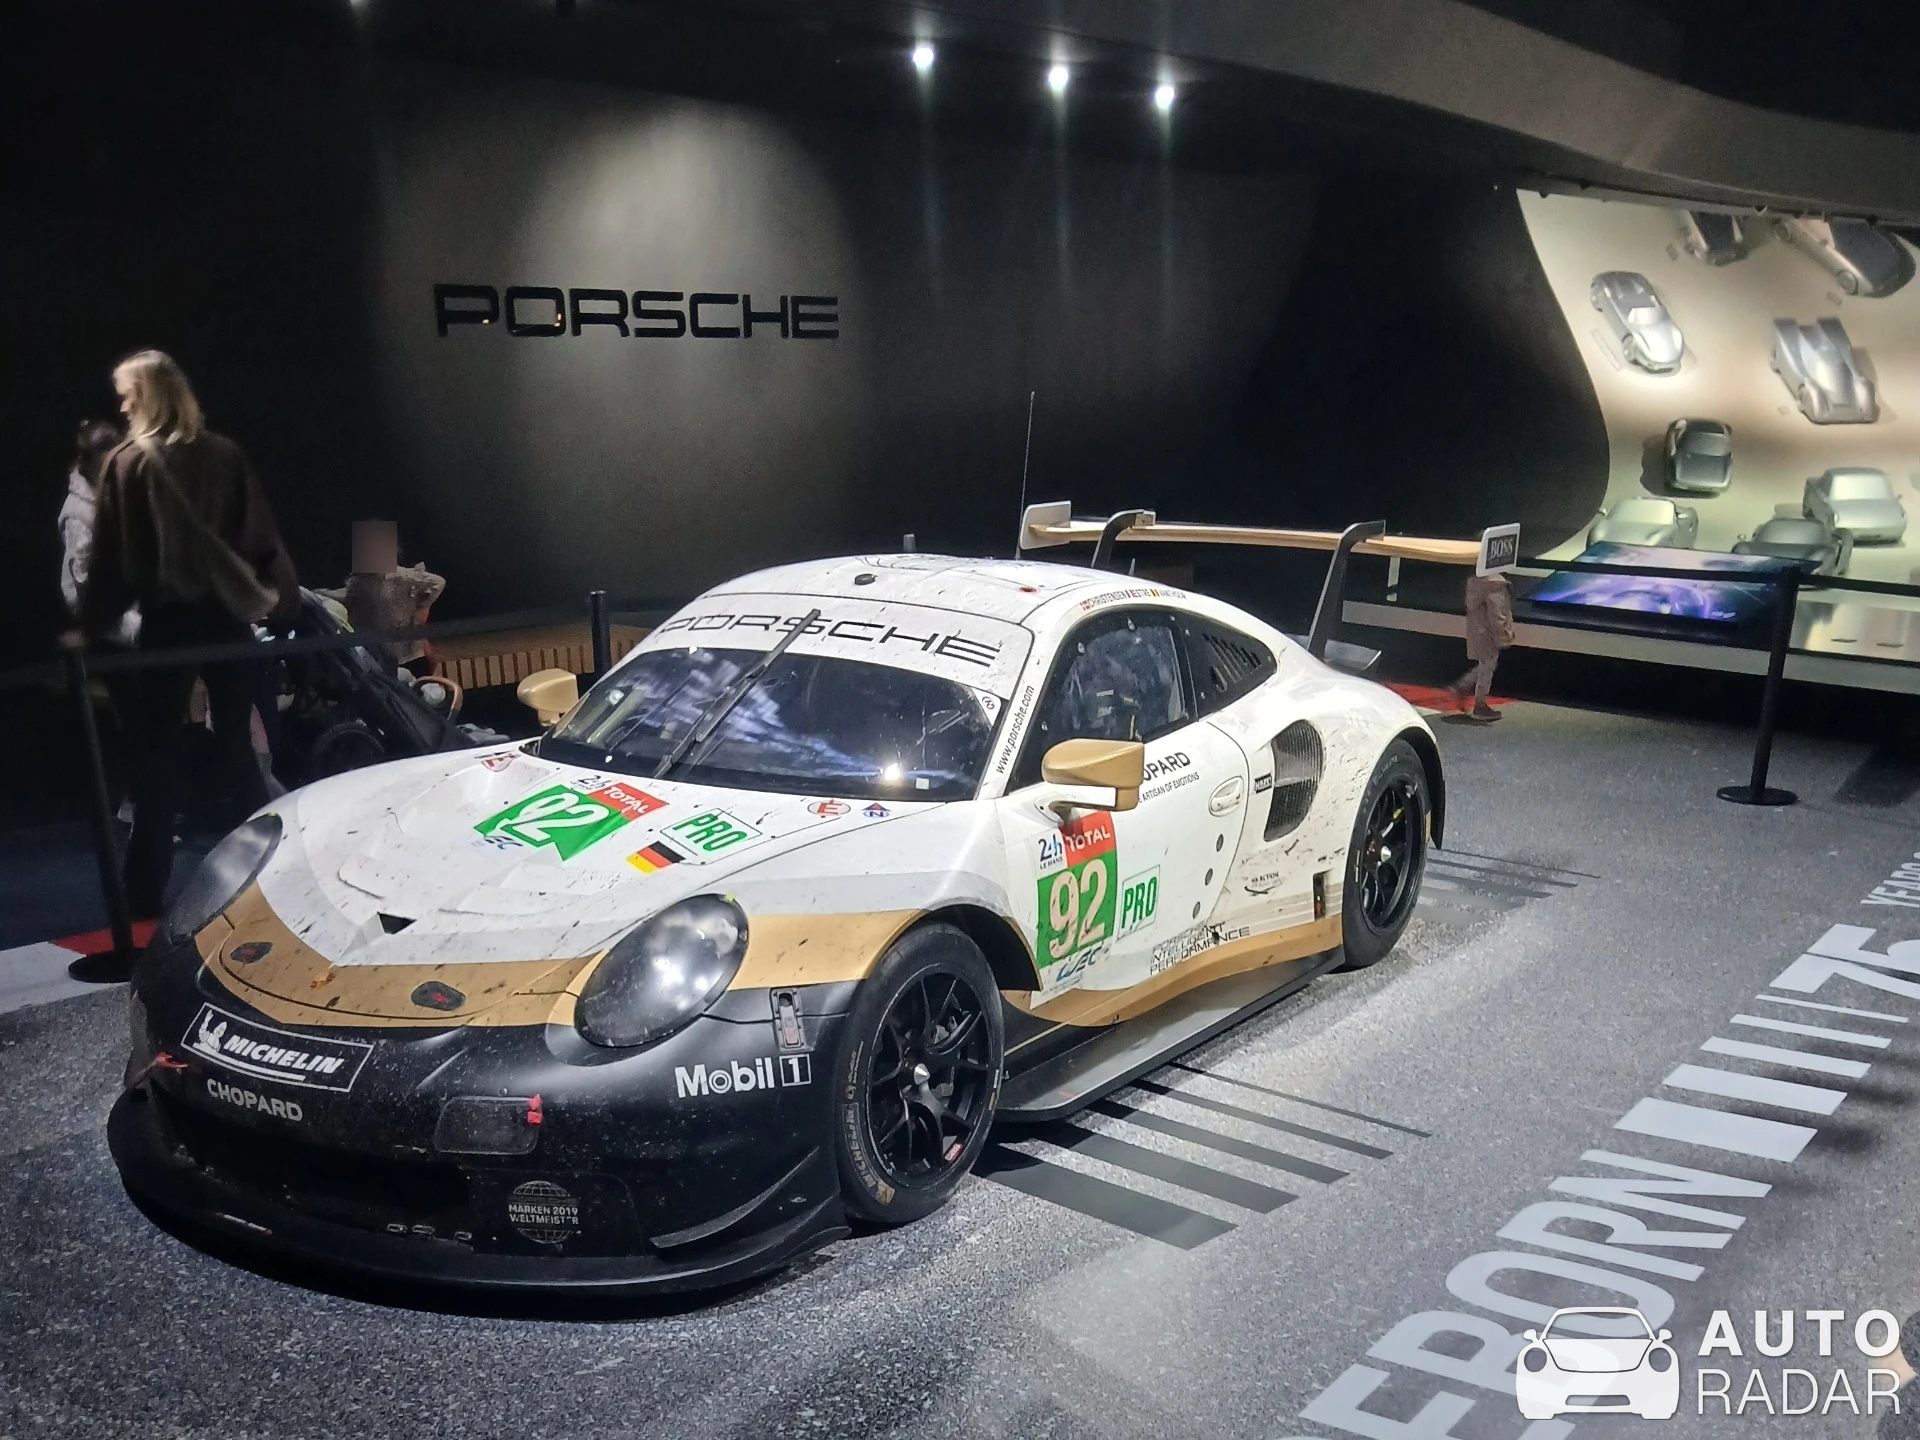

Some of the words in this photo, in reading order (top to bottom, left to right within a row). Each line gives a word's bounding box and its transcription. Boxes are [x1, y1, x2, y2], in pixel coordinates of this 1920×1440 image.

[433, 284, 840, 339] PORSCHE
[1490, 538, 1513, 560] BOSS
[659, 614, 1001, 667] PORSCHE
[996, 685, 1035, 775] www.porsche.com
[603, 786, 651, 814] TOTAL
[1142, 786, 1166, 802] ARTISAN
[1165, 782, 1173, 793] OF
[1173, 772, 1200, 790] EMOTIONS
[485, 793, 609, 841] 92
[672, 813, 747, 851] PRO
[1065, 825, 1111, 853] TOTAL
[1049, 859, 1107, 959] 92
[1121, 877, 1157, 929] PRO
[1150, 926, 1250, 976] PERFORMANCE
[223, 1035, 345, 1074] MICHELIN
[674, 1057, 775, 1098] Mobil
[207, 1078, 303, 1122] CHOPARD
[846, 1108, 876, 1188] MICHELIN
[508, 1204, 550, 1214] MARKEN
[553, 1206, 578, 1216] 2019
